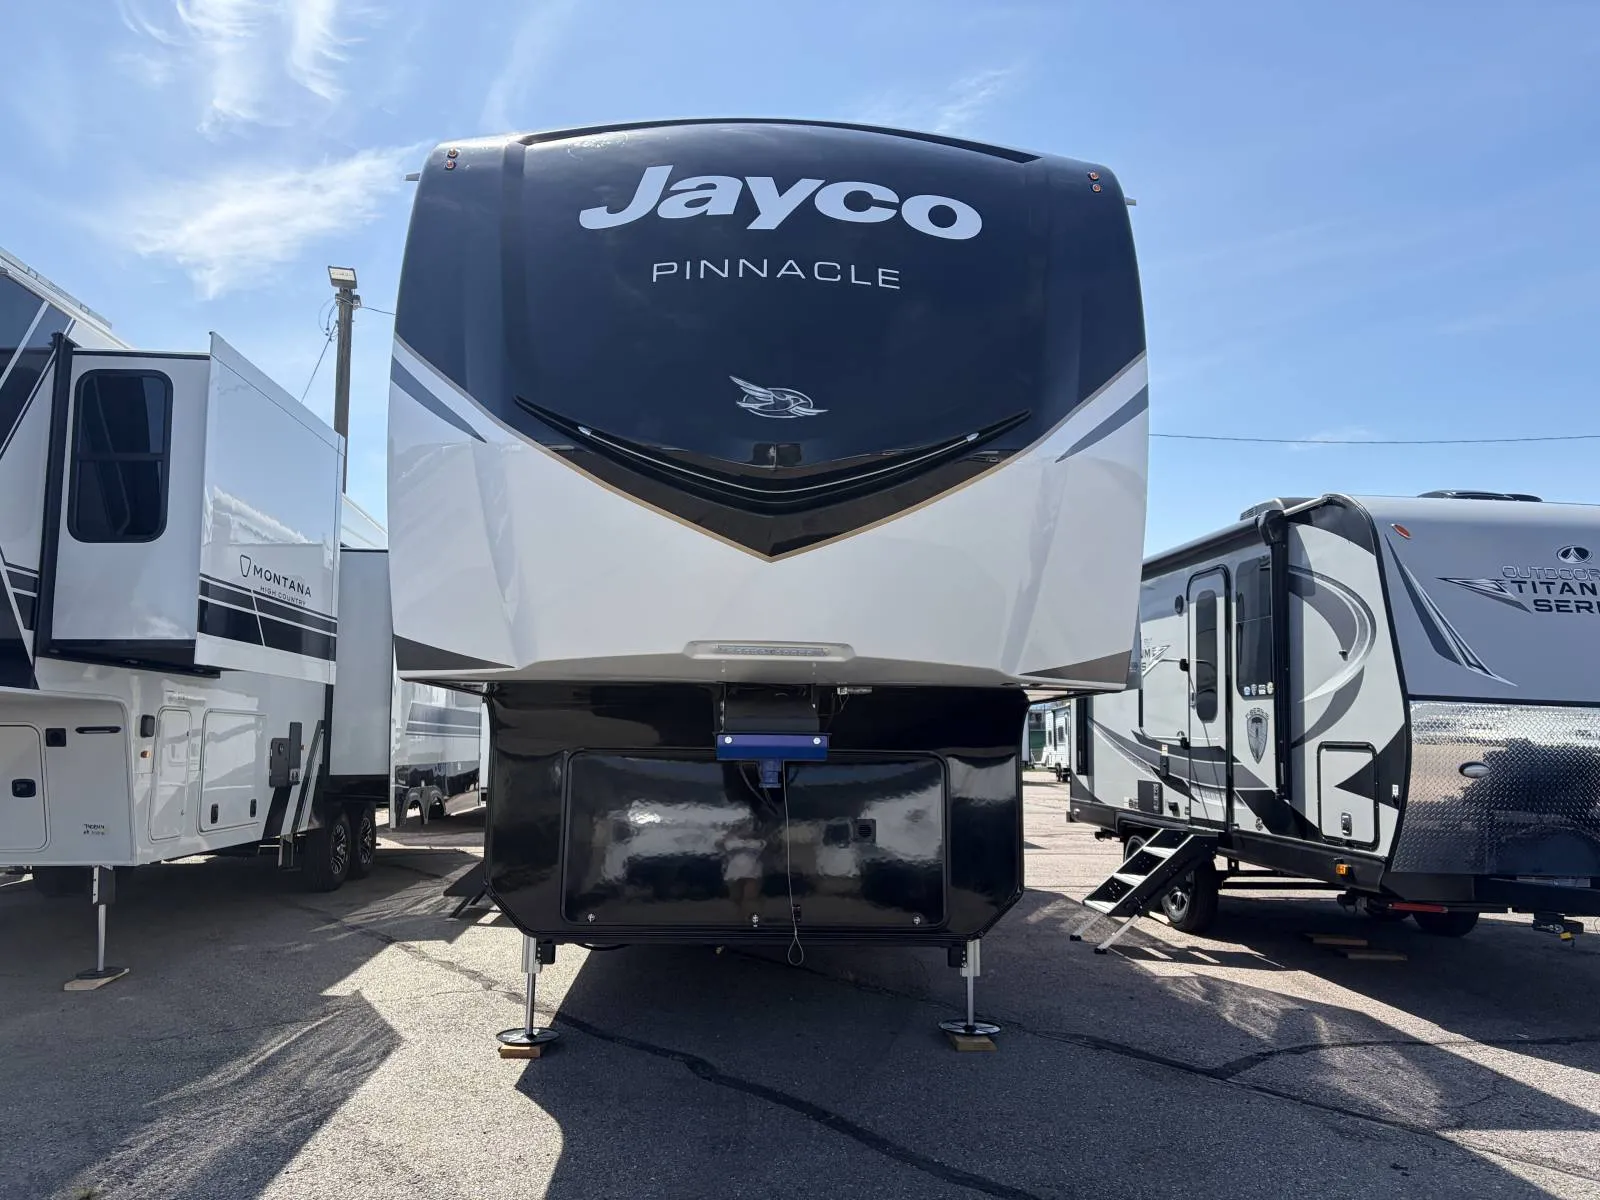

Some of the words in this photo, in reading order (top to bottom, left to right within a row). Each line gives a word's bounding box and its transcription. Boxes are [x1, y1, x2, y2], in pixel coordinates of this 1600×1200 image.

[579, 165, 983, 240] Jayco
[652, 258, 901, 290] PINNACLE
[253, 564, 312, 598] MONTANA
[260, 586, 277, 596] HIGH
[278, 592, 306, 606] COUNTRY
[1510, 580, 1598, 596] TITAN
